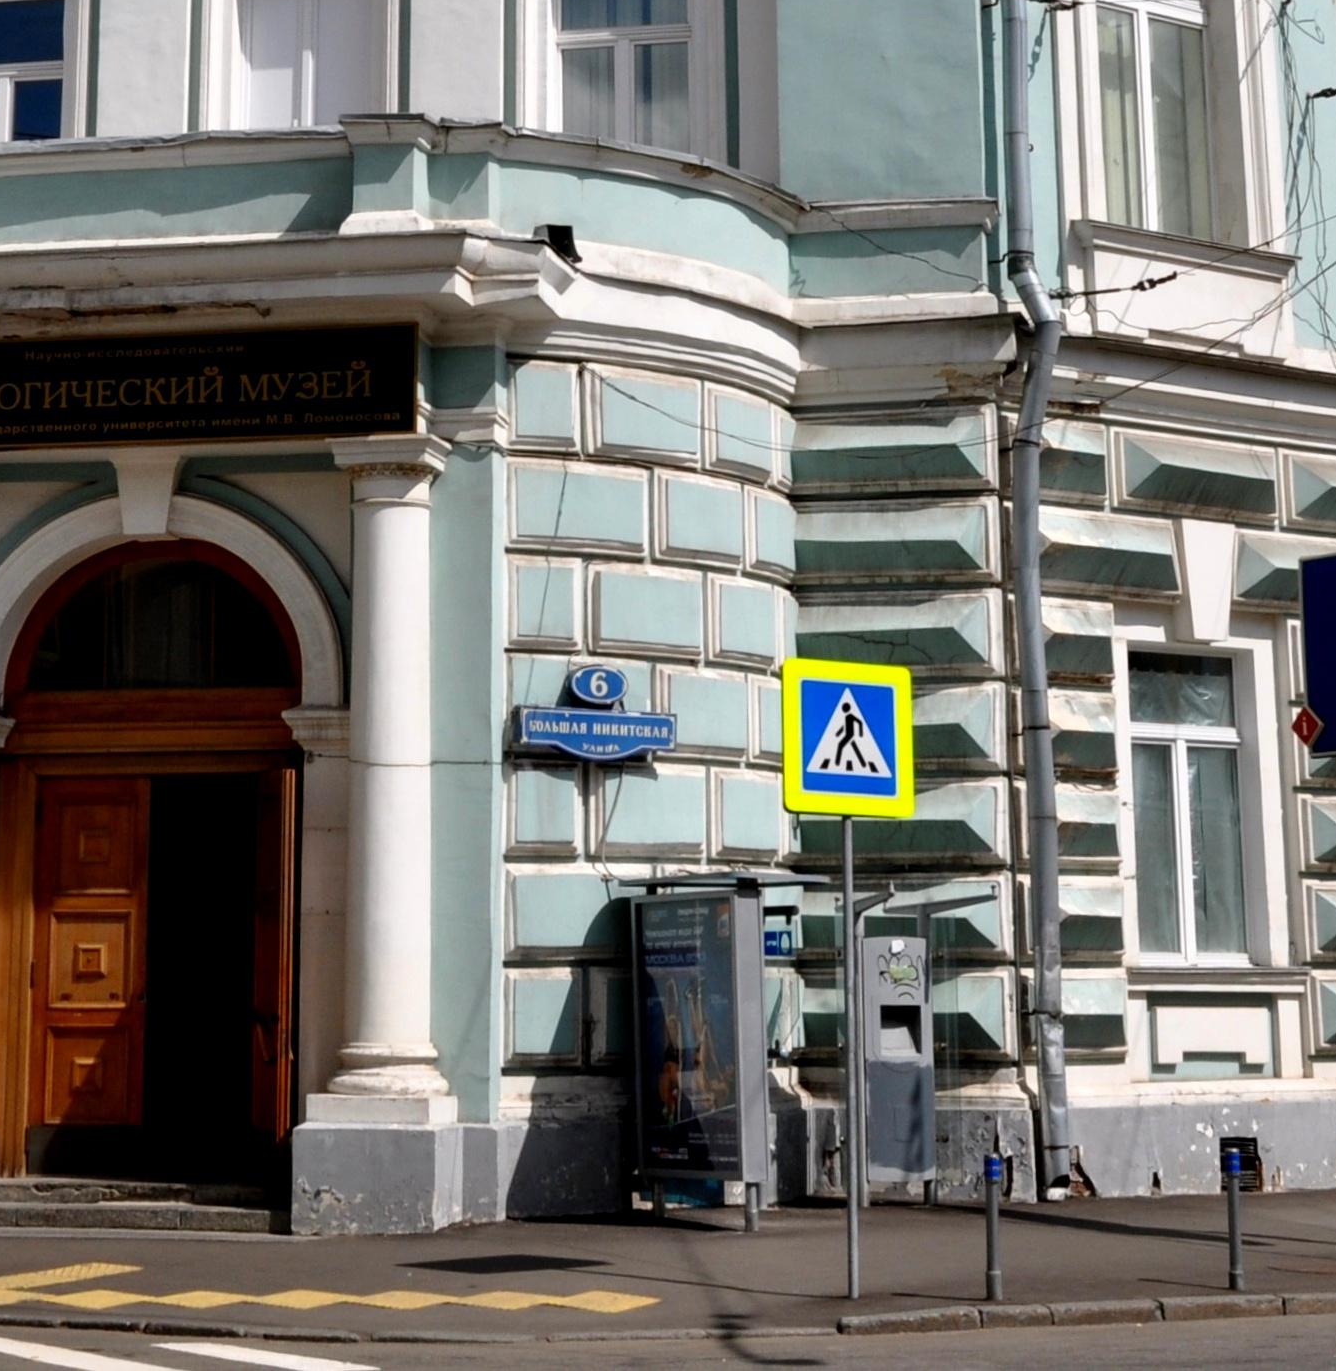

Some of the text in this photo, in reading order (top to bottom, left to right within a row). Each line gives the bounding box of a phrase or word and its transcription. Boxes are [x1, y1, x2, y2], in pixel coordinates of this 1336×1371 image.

[238, 359, 373, 403] МУЗЕЙ
[102, 418, 206, 435] университета
[211, 416, 261, 428] имени
[303, 410, 402, 425] Ломоносова
[589, 671, 609, 698] 6
[528, 719, 669, 739] БОЛЬШАЯ НИКИТСКАЯ
[581, 742, 621, 753] УЛИЦА
